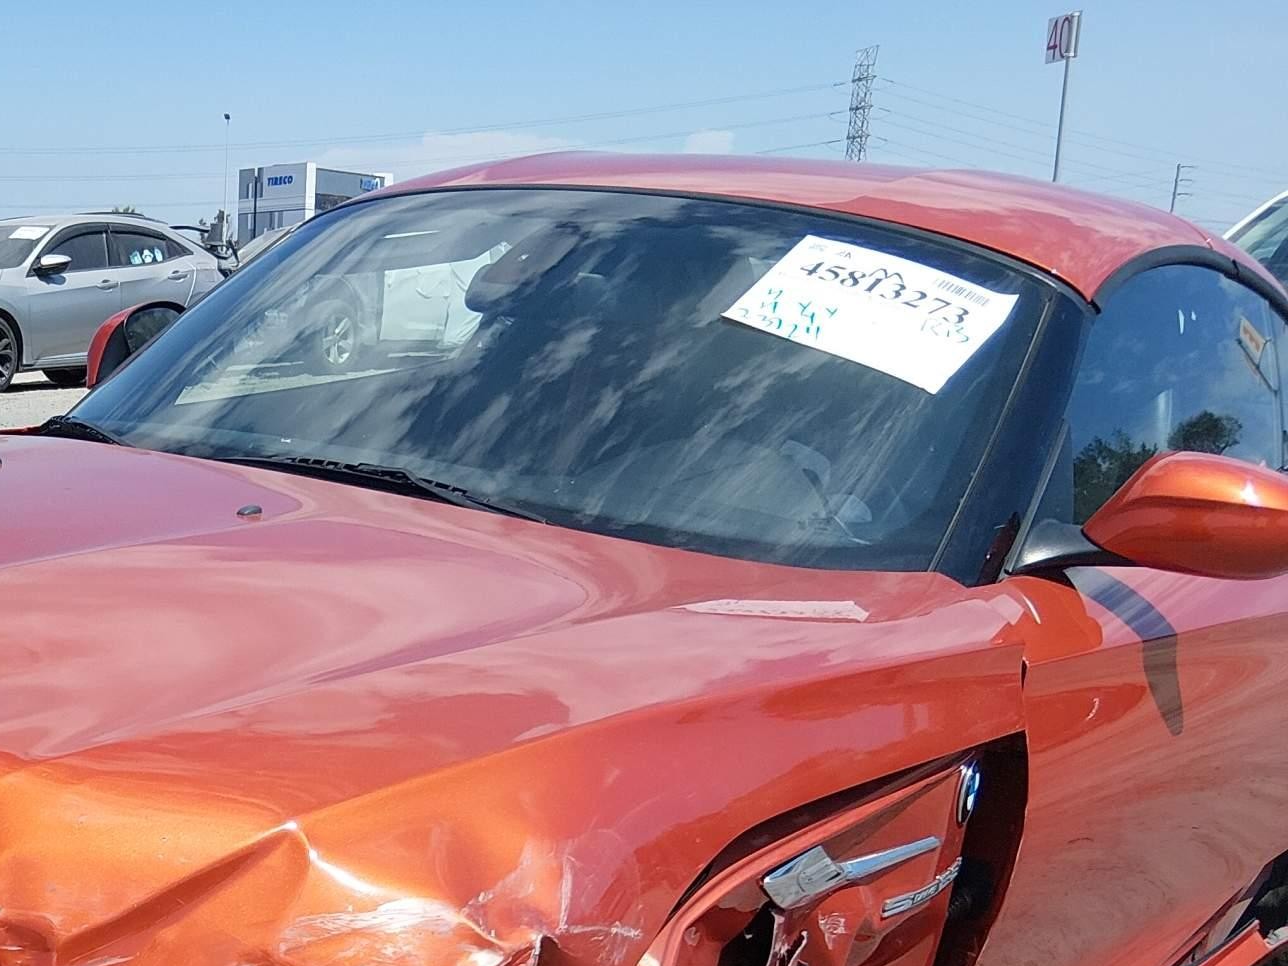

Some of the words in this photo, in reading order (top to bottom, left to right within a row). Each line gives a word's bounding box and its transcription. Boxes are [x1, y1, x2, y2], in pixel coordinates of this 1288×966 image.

[1046, 16, 1072, 61] 40
[267, 174, 294, 188] TIRECO
[799, 260, 971, 327] 45813273
